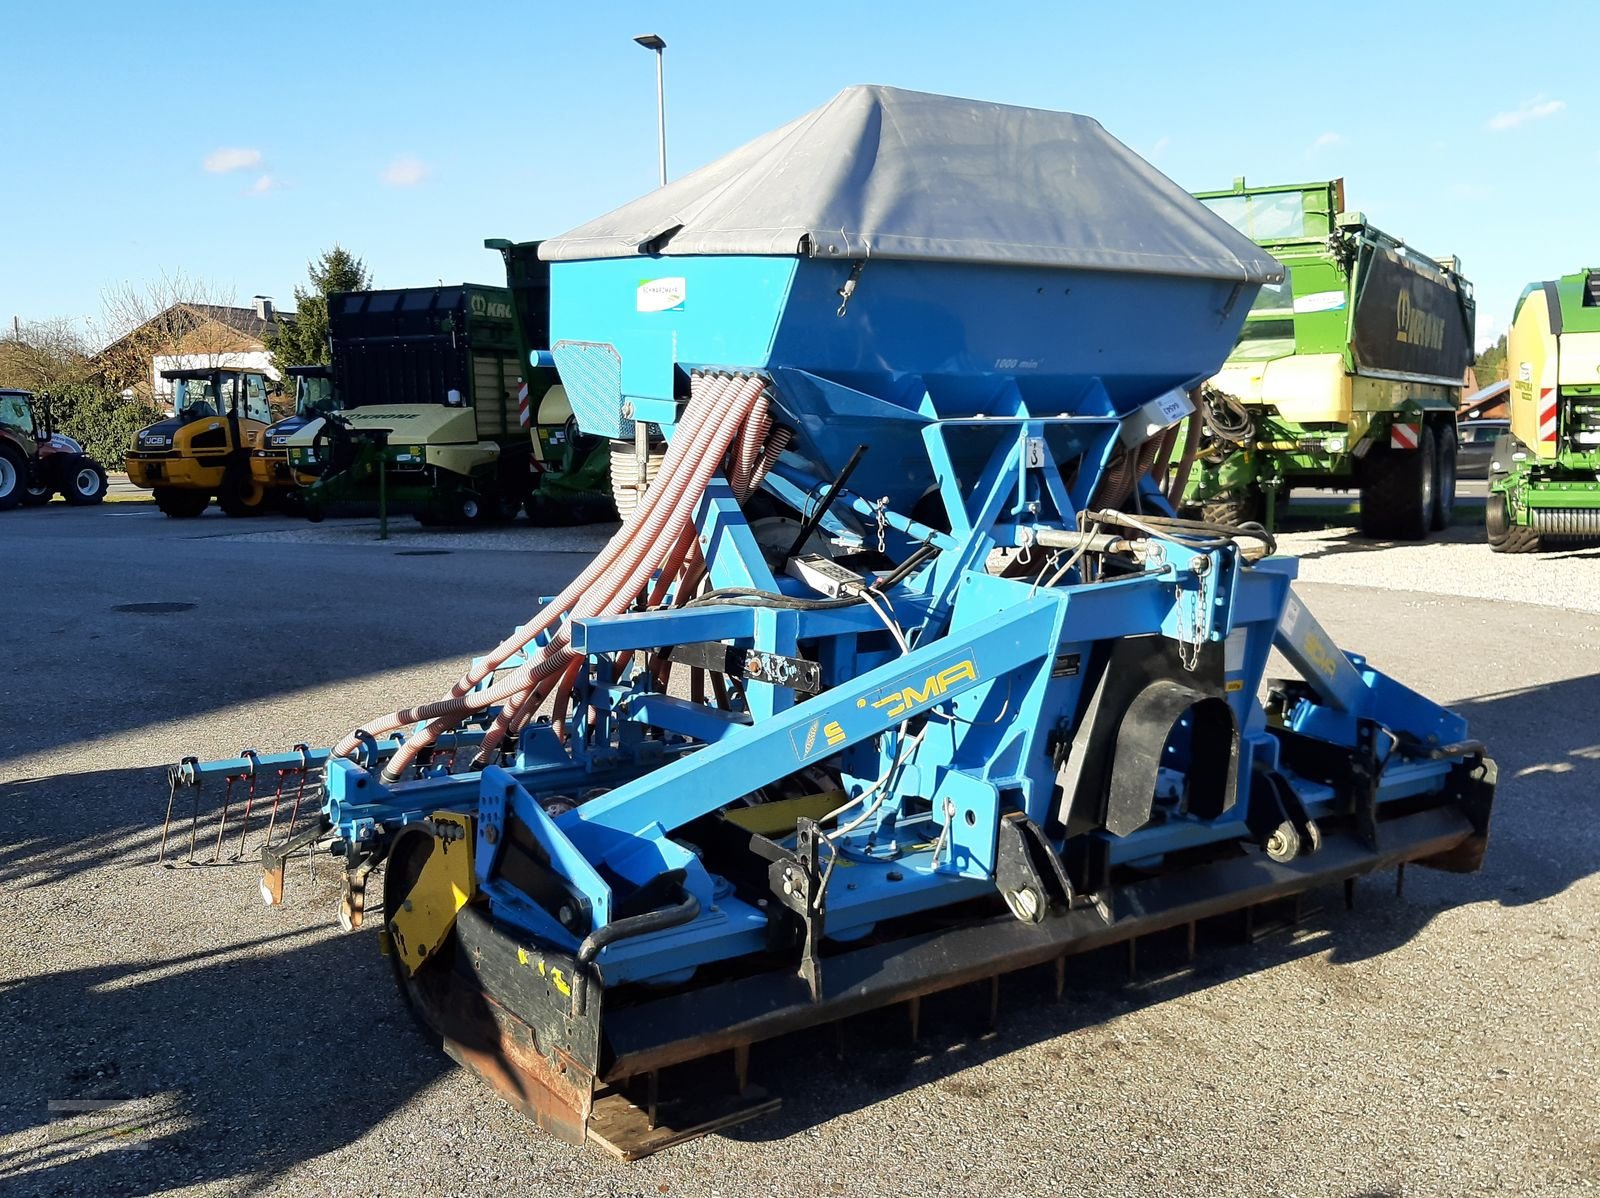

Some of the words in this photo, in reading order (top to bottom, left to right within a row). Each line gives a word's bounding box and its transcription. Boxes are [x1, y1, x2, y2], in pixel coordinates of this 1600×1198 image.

[1408, 307, 1446, 351] KRONE
[994, 358, 1018, 369] 1000
[145, 437, 163, 445] JCB
